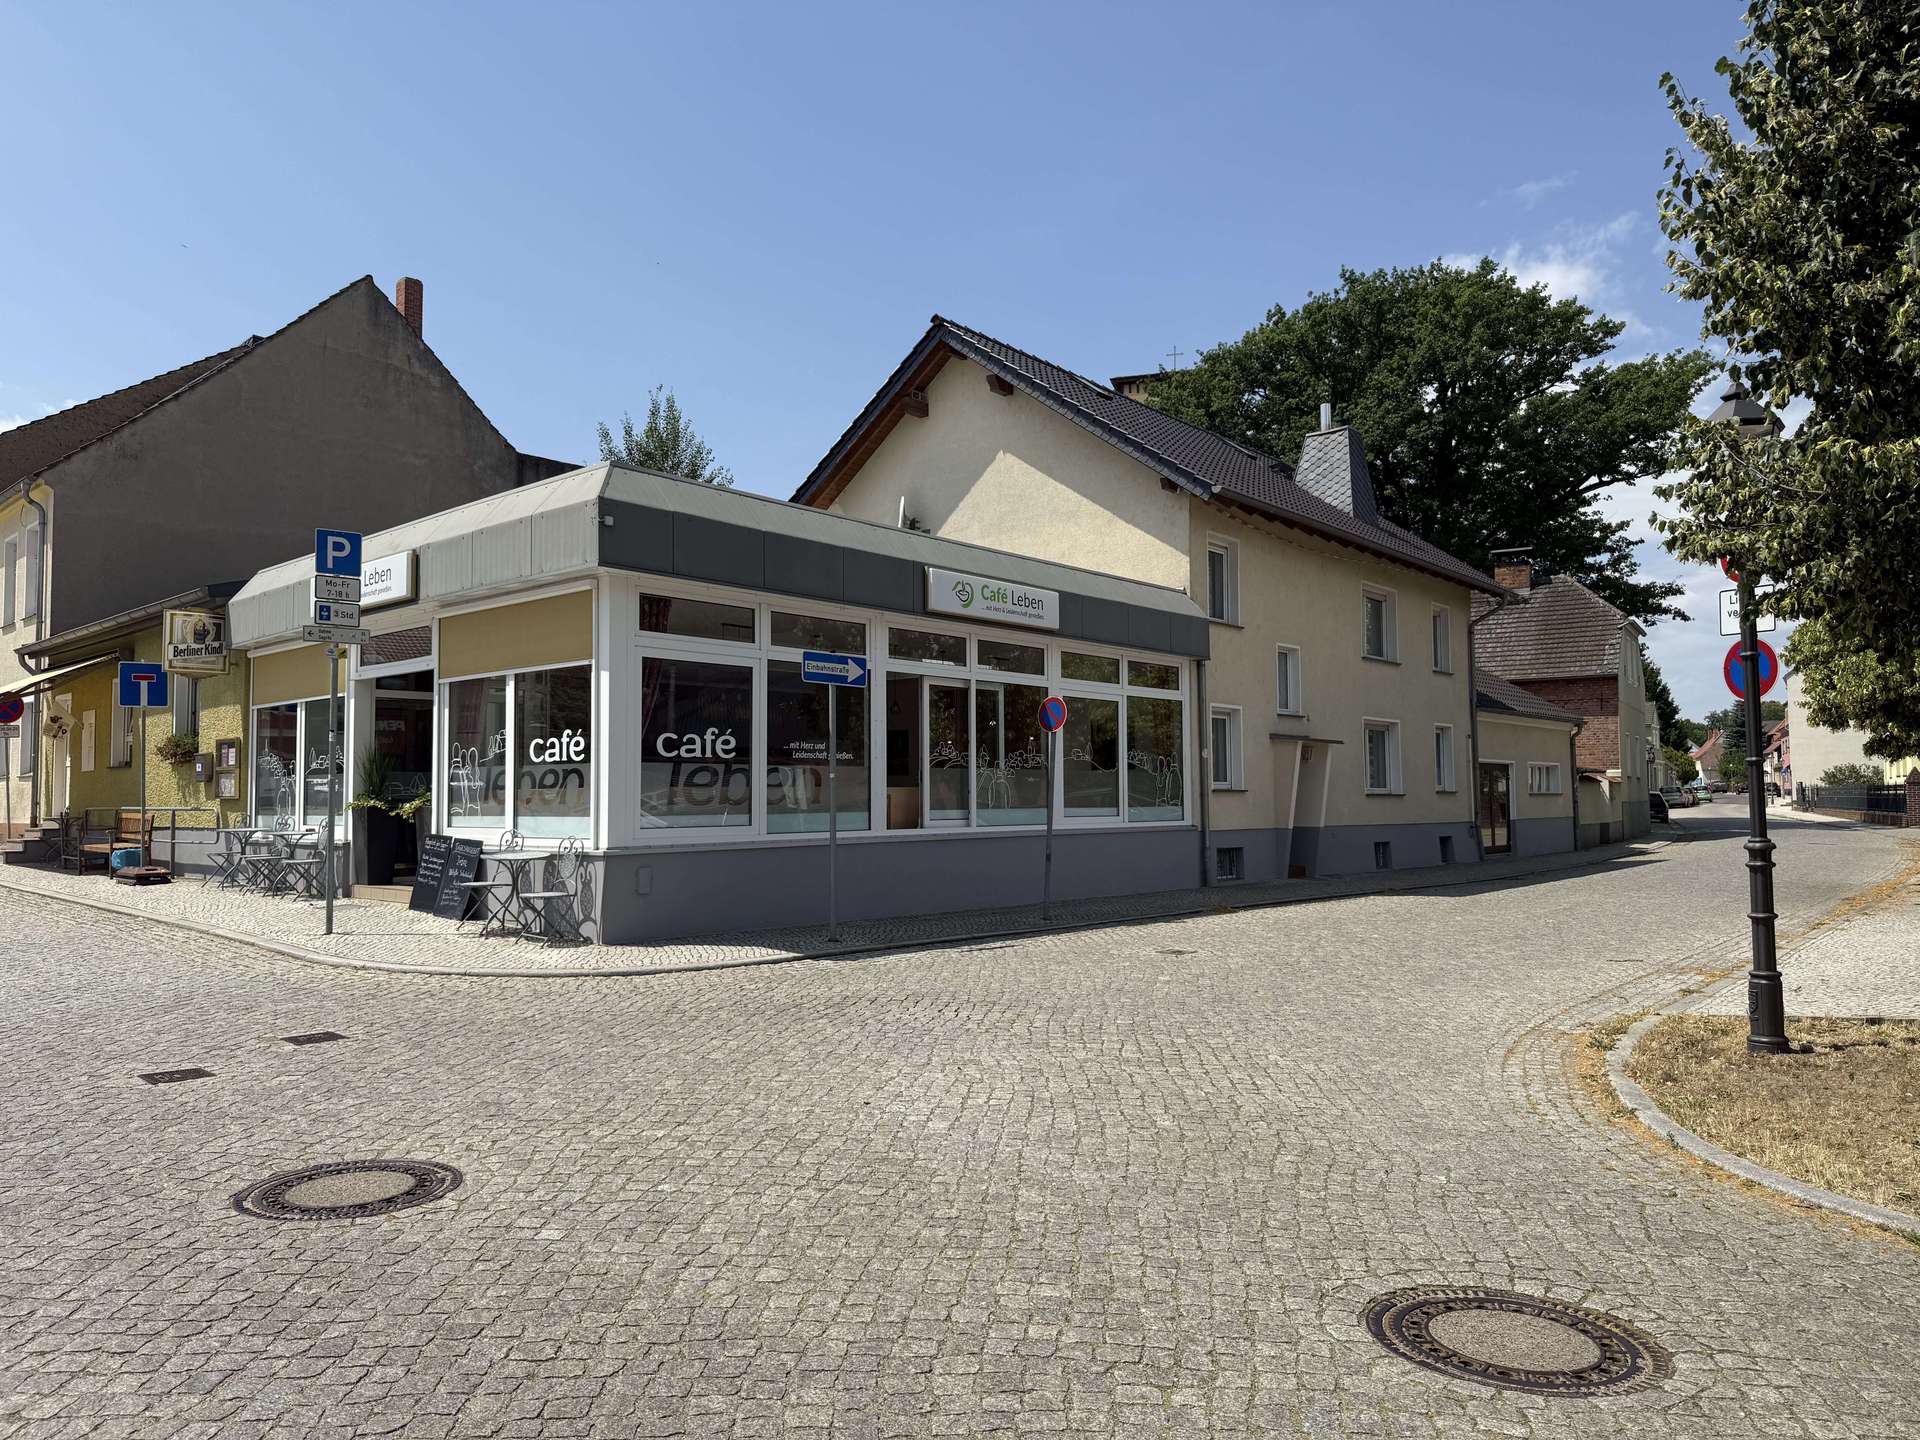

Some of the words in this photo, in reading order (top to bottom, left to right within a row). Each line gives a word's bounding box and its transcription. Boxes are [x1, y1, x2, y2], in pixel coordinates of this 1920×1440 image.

[327, 536, 351, 569] P
[325, 580, 351, 589] Mo-Fr
[364, 566, 392, 587] Leben
[327, 589, 342, 598] 7-18
[981, 584, 1008, 604] Café
[1011, 590, 1044, 611] Leben
[333, 609, 339, 618] 3
[173, 644, 204, 658] Berliner
[205, 642, 224, 656] Kindl
[529, 729, 585, 763] café
[656, 728, 737, 759] café
[800, 741, 814, 750] Herz
[815, 742, 826, 750] und
[792, 750, 827, 760] Leidenschaft
